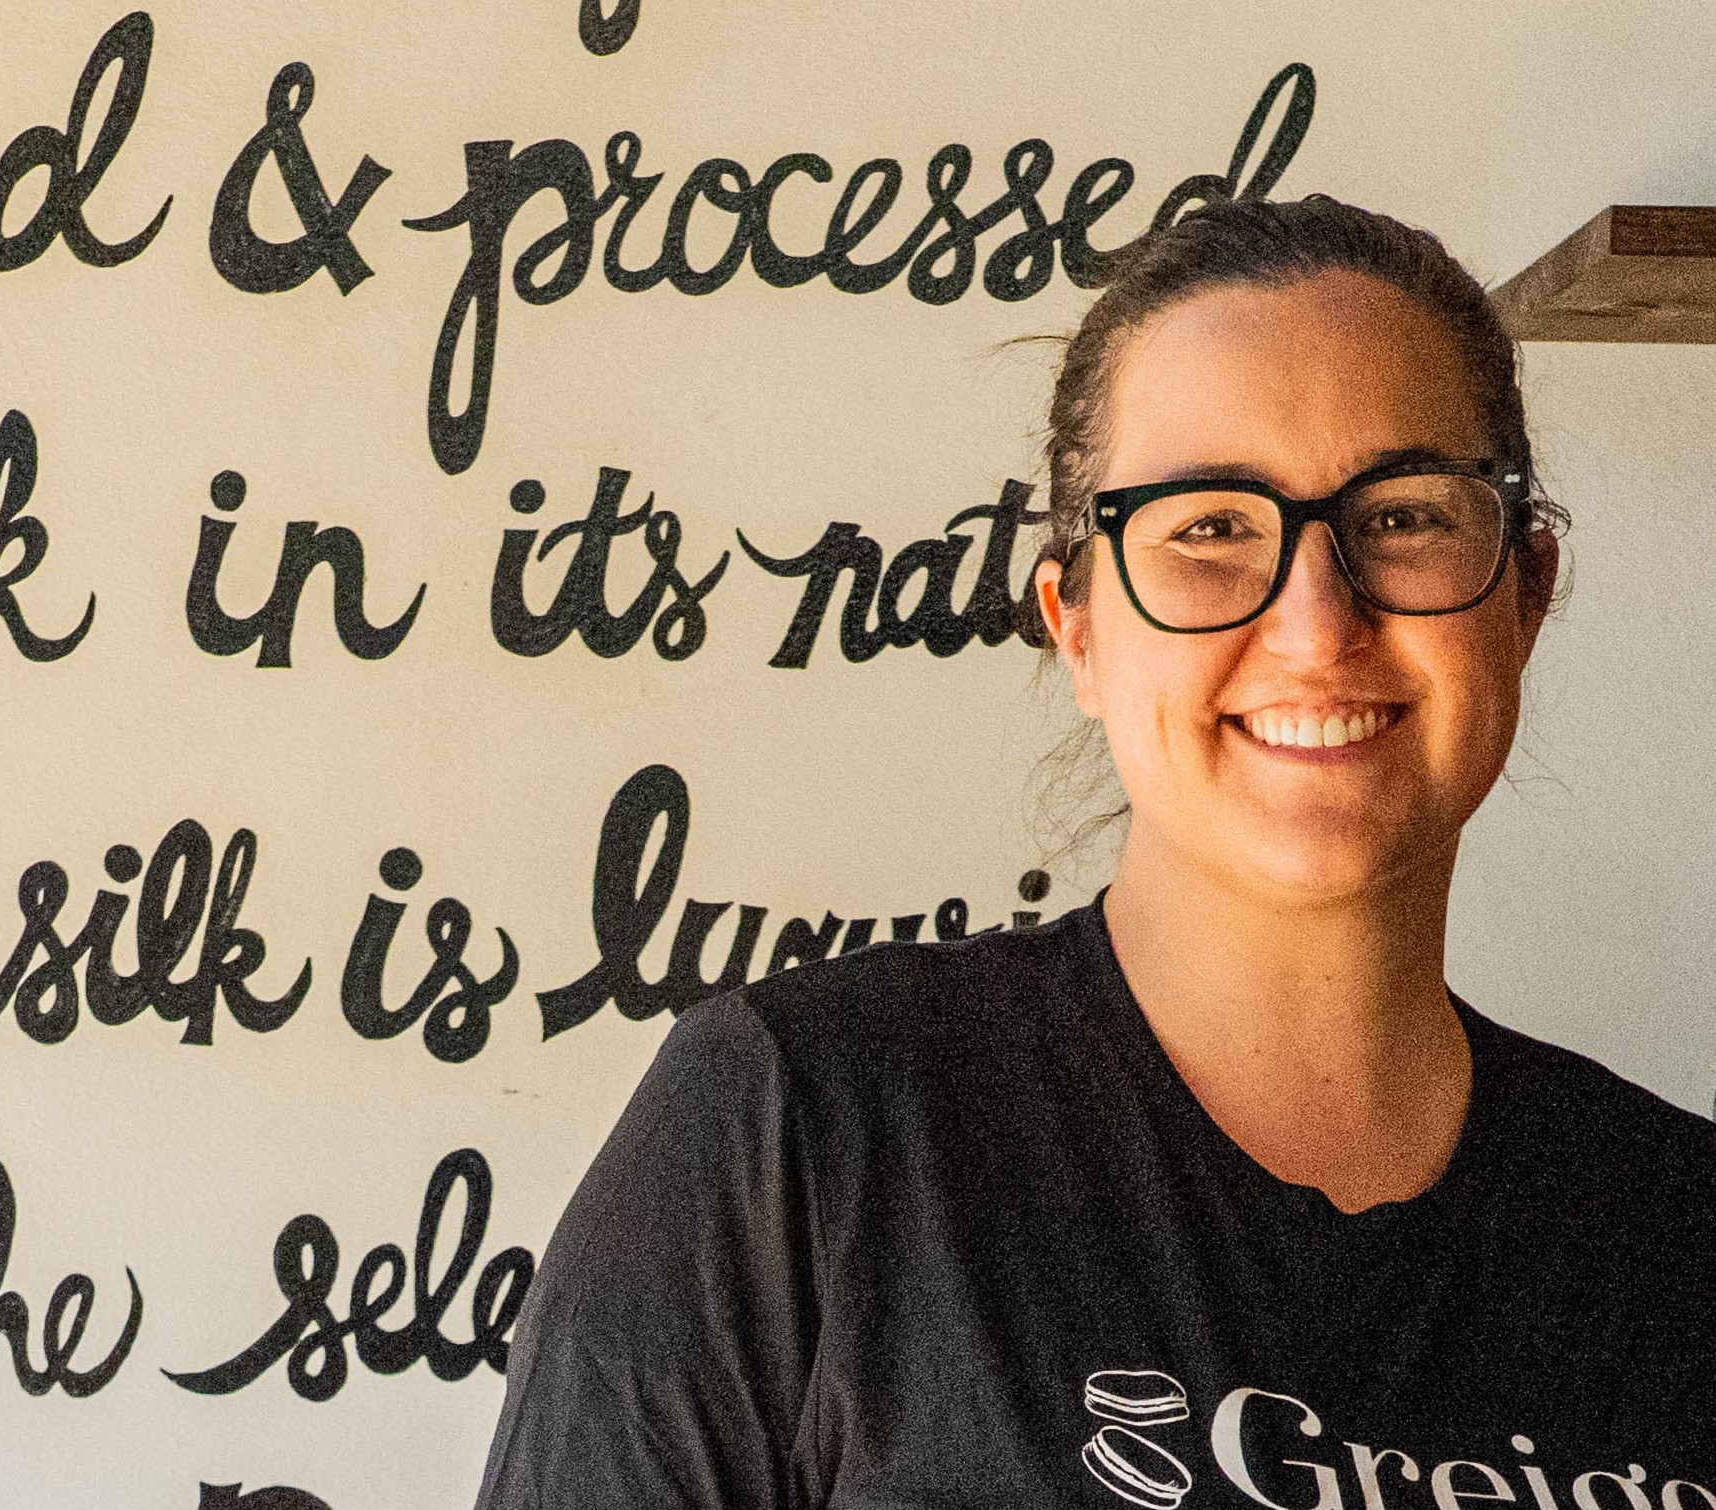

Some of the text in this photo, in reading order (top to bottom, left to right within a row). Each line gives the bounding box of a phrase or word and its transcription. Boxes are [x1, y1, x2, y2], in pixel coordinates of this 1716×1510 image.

[207, 60, 394, 298] &
[401, 62, 1317, 476] processed
[184, 469, 428, 669] in
[736, 479, 1051, 669] nat
[340, 846, 520, 1063] is
